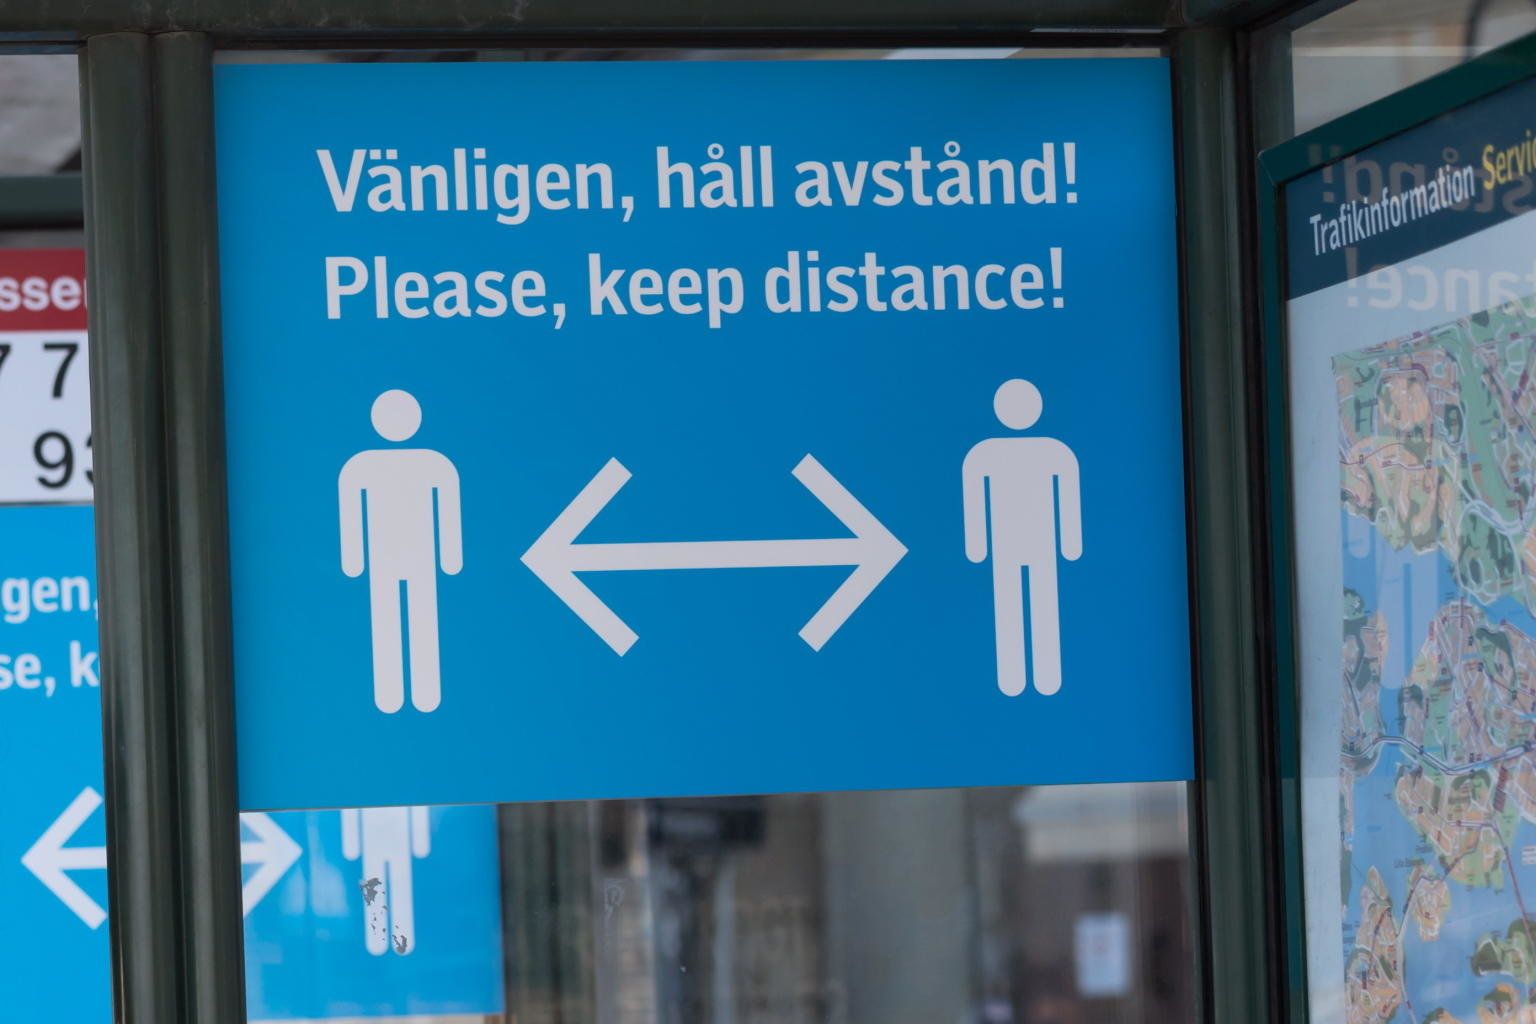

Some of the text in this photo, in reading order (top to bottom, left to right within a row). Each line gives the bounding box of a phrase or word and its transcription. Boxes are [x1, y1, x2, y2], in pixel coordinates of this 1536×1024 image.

[316, 141, 1078, 225] Vänligen, håll avstånd!
[1310, 164, 1476, 256] Trafikinformation
[325, 247, 1064, 330] Please, keep distance!
[43, 342, 79, 399] 7
[33, 430, 93, 490] 9
[69, 640, 100, 688] k
